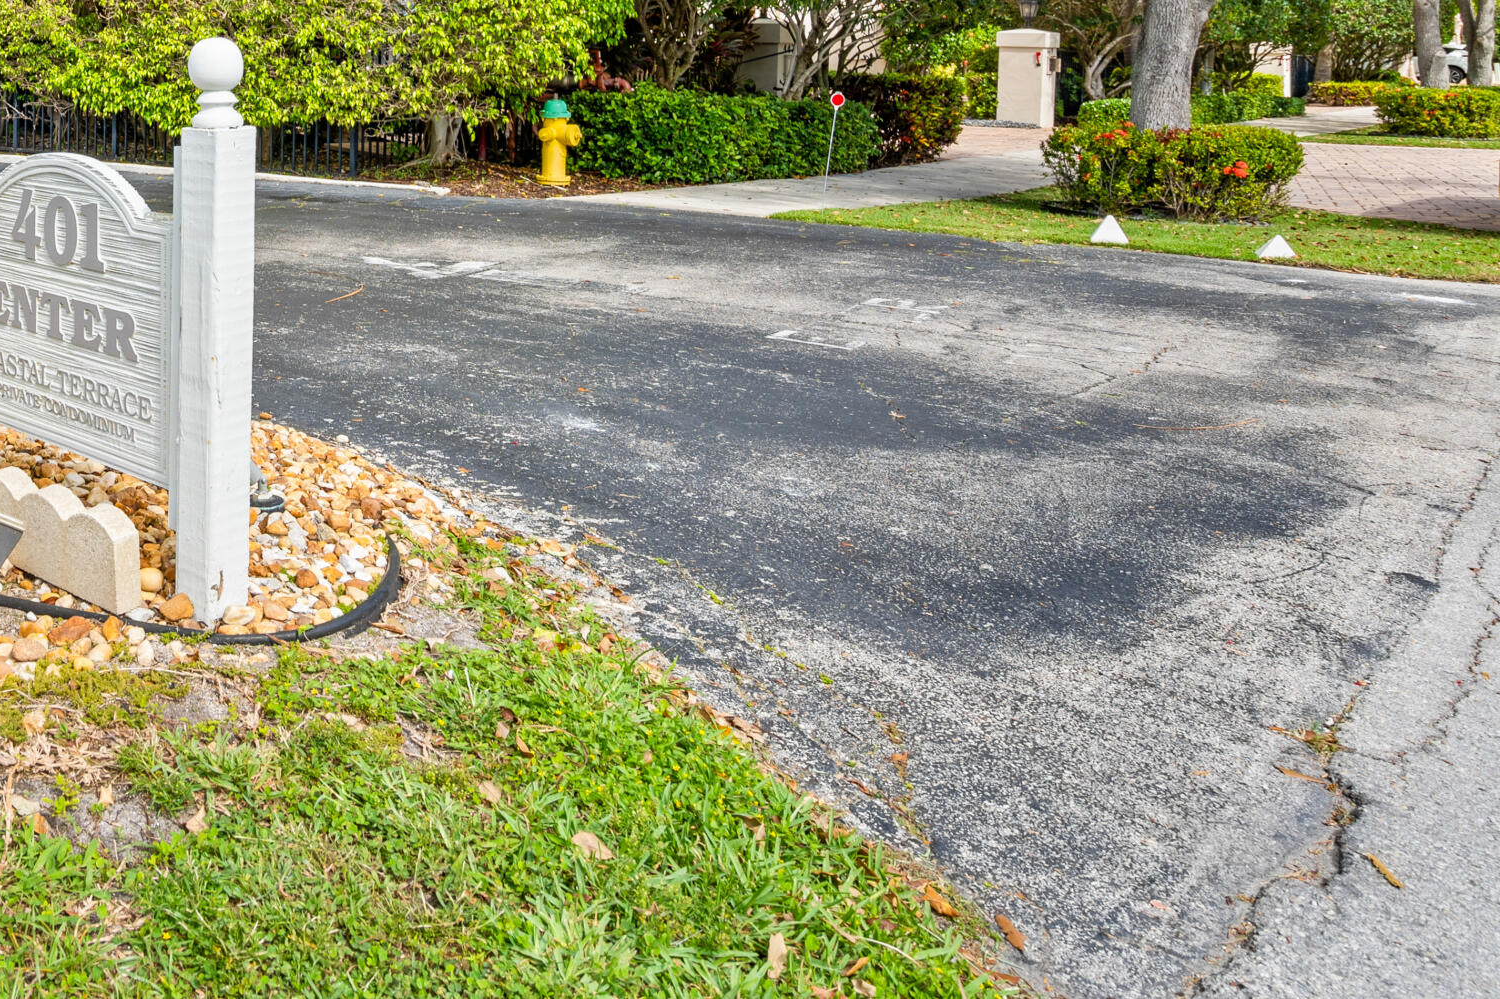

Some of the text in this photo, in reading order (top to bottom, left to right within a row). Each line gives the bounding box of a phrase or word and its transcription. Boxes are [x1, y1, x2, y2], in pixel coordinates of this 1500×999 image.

[11, 189, 105, 273] 401
[44, 396, 136, 442] CONDOMINIUM
[56, 369, 153, 422] TERRACE
